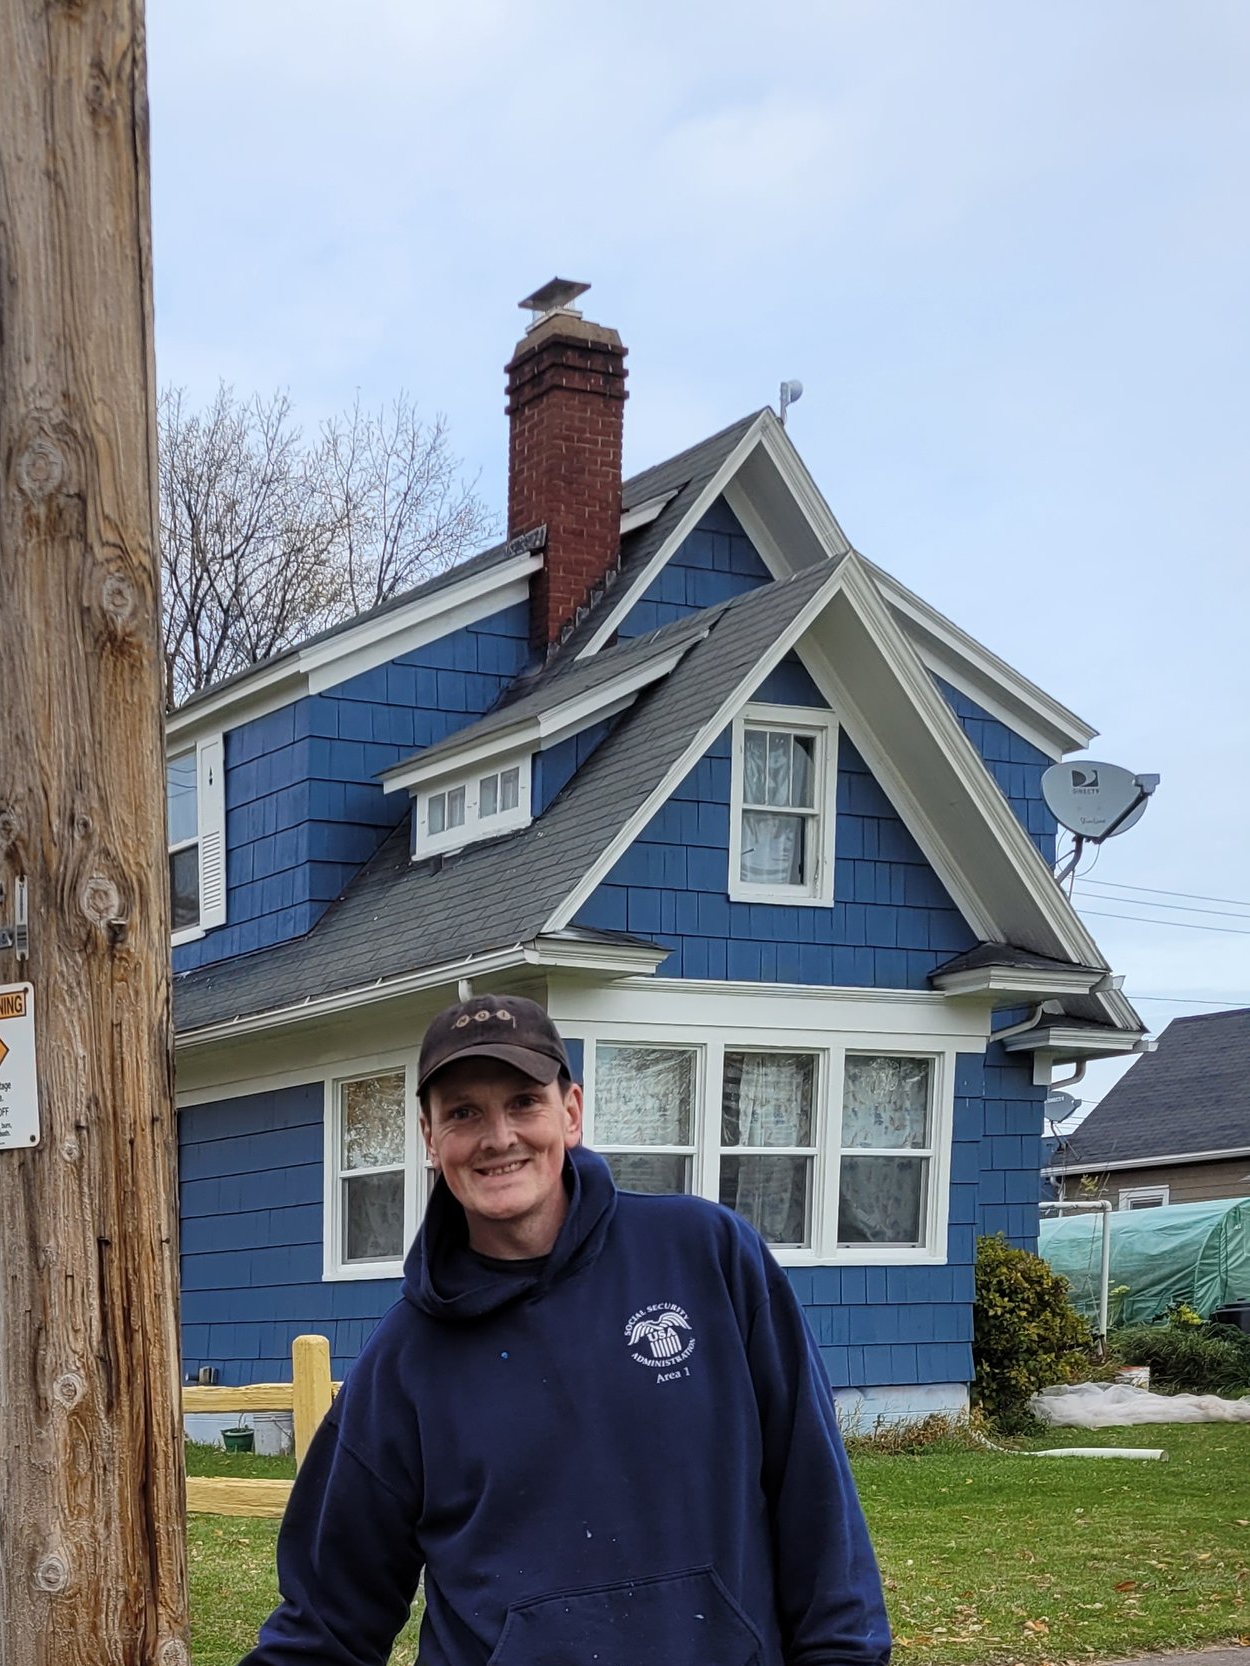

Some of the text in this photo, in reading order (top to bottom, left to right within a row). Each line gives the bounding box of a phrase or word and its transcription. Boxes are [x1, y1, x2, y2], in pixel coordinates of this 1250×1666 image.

[624, 1302, 690, 1336] SOCIAL SECURITY
[647, 1326, 677, 1342] USA
[631, 1338, 696, 1367] ADMINISTRATION
[656, 1366, 690, 1384] Area 1
